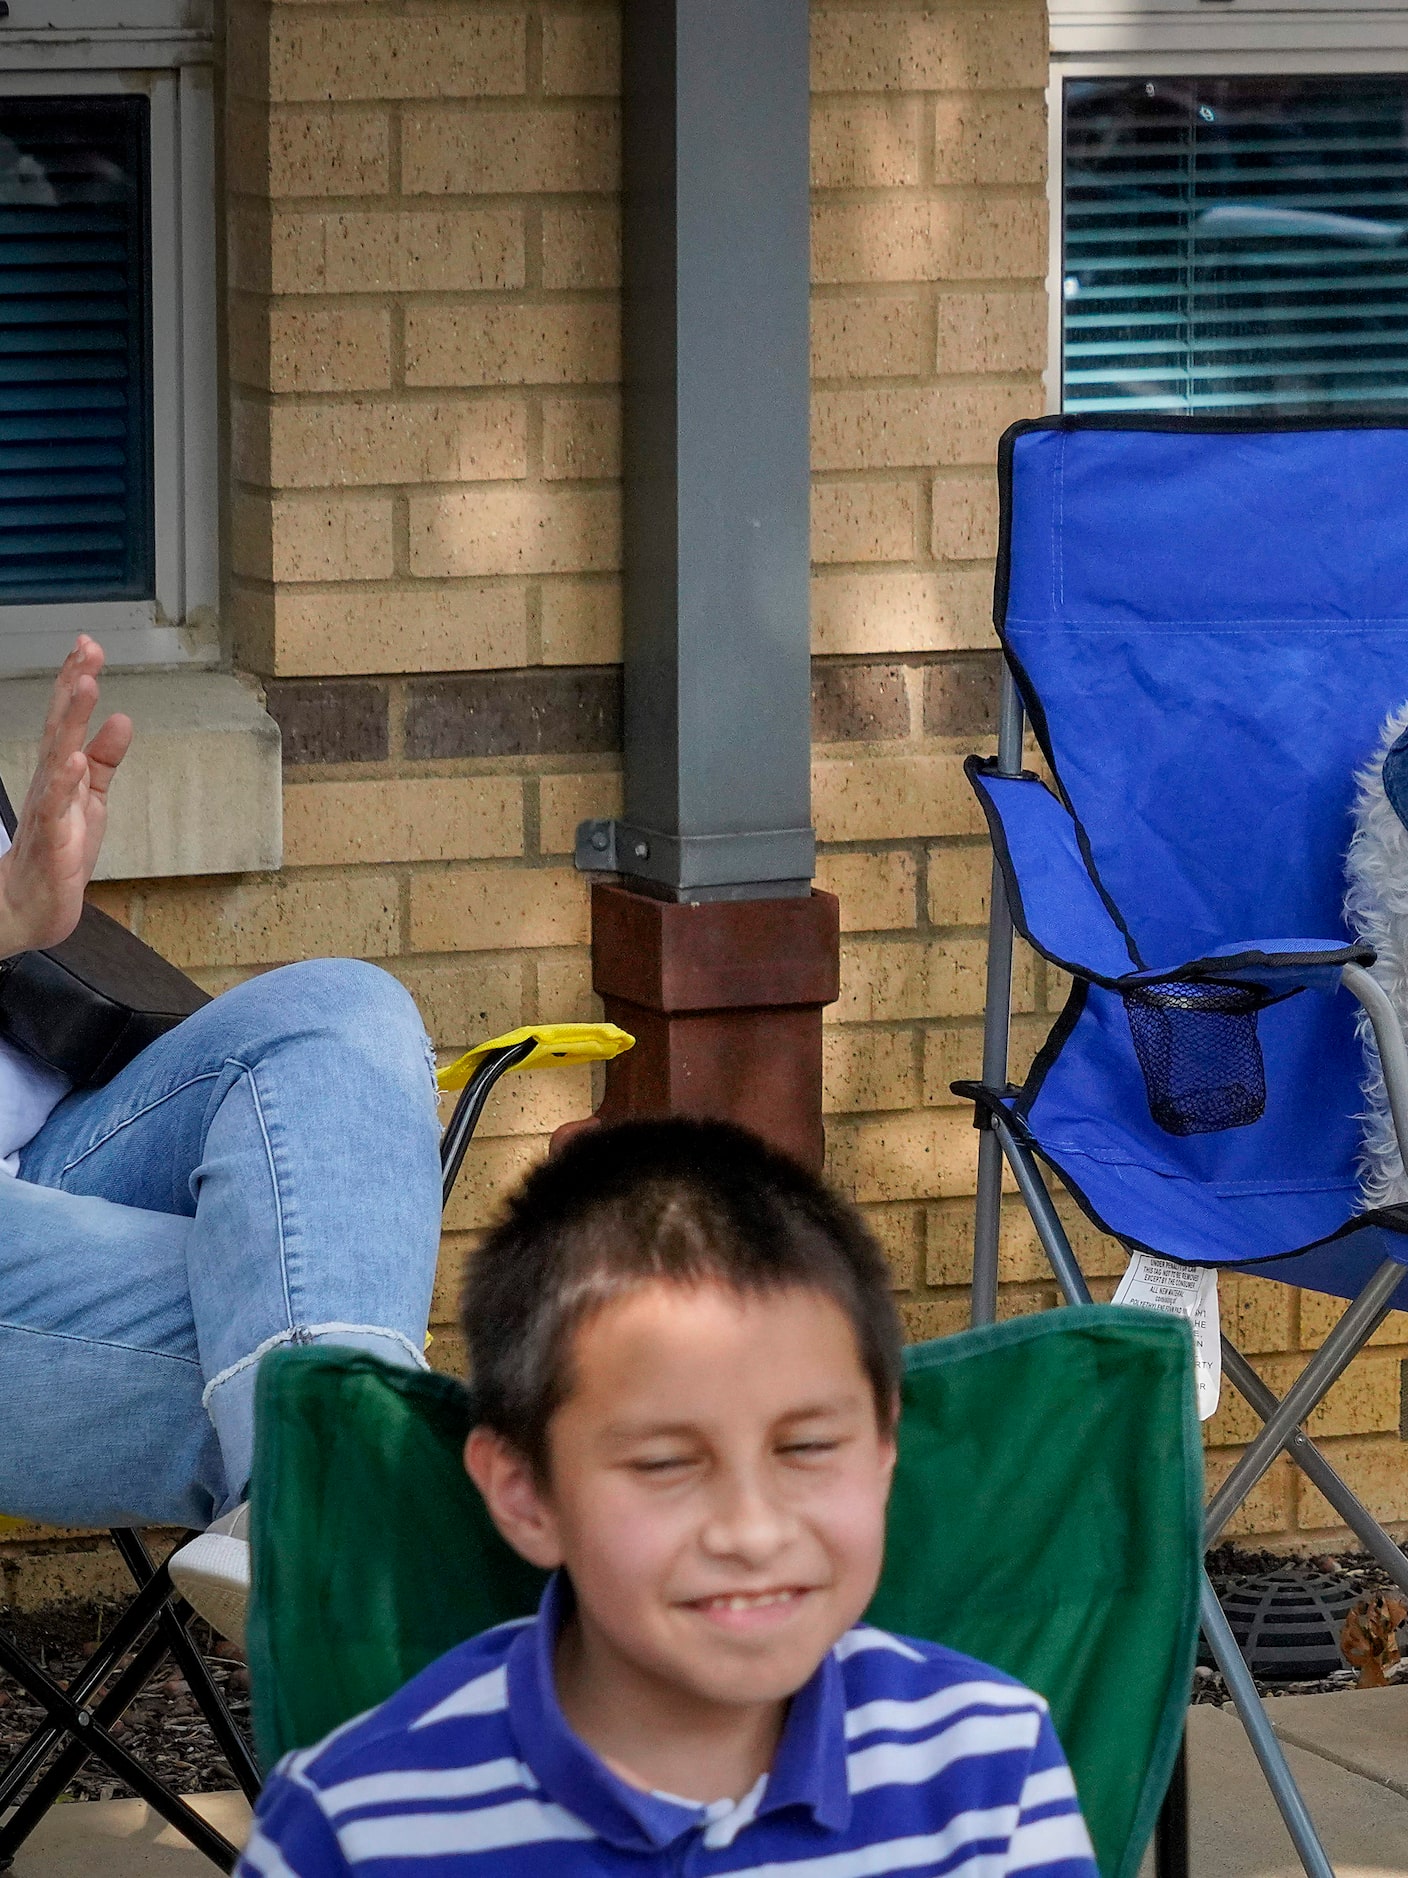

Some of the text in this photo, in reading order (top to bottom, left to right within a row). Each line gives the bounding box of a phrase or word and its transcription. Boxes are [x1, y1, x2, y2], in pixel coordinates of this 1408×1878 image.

[1150, 1259, 1164, 1267] UNDER
[1144, 1273, 1161, 1282] EXCEPT
[1175, 1279, 1195, 1289] CONSUMER
[1182, 1272, 1199, 1281] REMOVED
